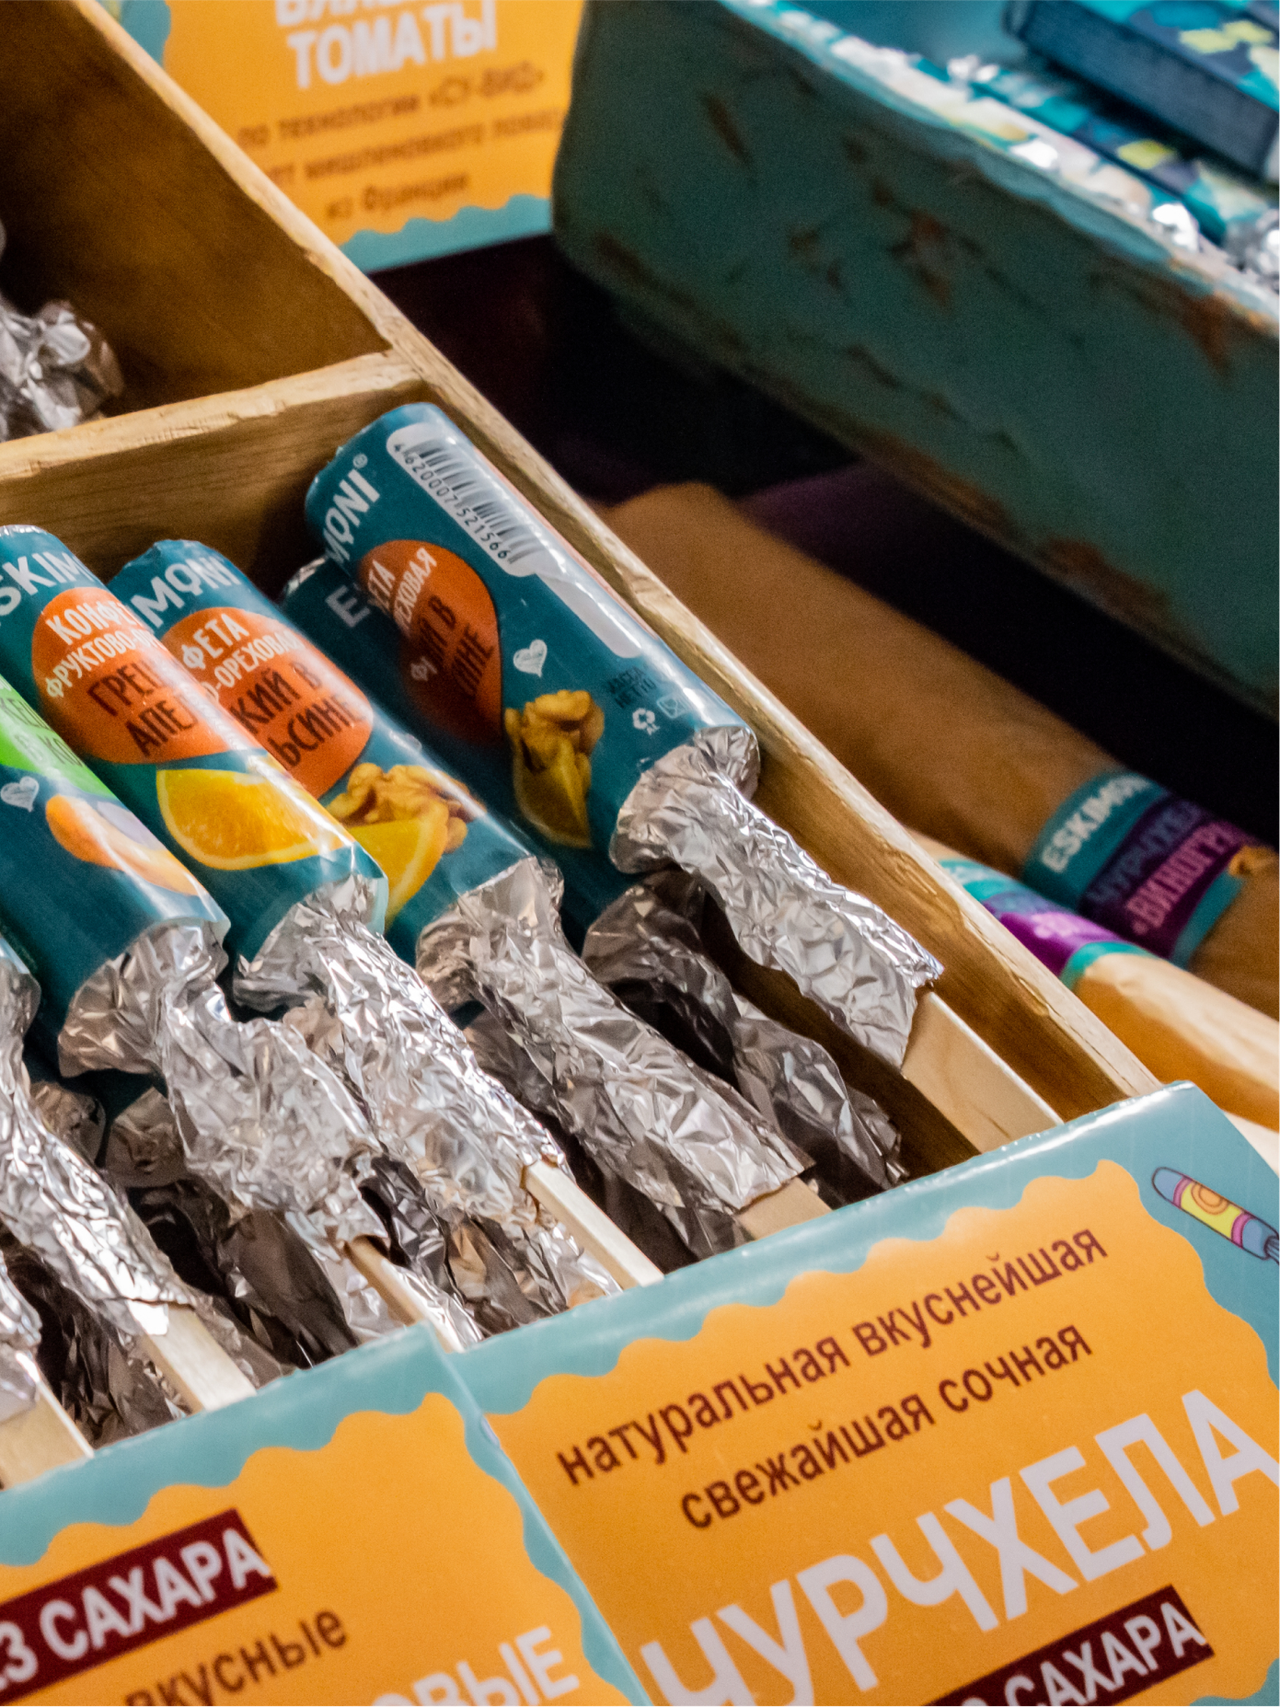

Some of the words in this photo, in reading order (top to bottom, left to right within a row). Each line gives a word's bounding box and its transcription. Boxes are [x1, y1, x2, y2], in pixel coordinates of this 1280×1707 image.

[287, 0, 497, 89] ТОМАТЫ
[182, 613, 250, 670] ФЕТА
[230, 667, 302, 735] КИЙ
[267, 694, 366, 767] ЬСИНЕ
[557, 1335, 852, 1487] натуральная
[851, 1228, 1109, 1357] вкуснейшая
[680, 1390, 937, 1531] свежайшая
[937, 1324, 1093, 1414] сочная
[40, 1526, 273, 1662] САХАРА
[639, 1388, 1280, 1707] ЧУРЧХЕЛА
[124, 1609, 349, 1707] вкусные
